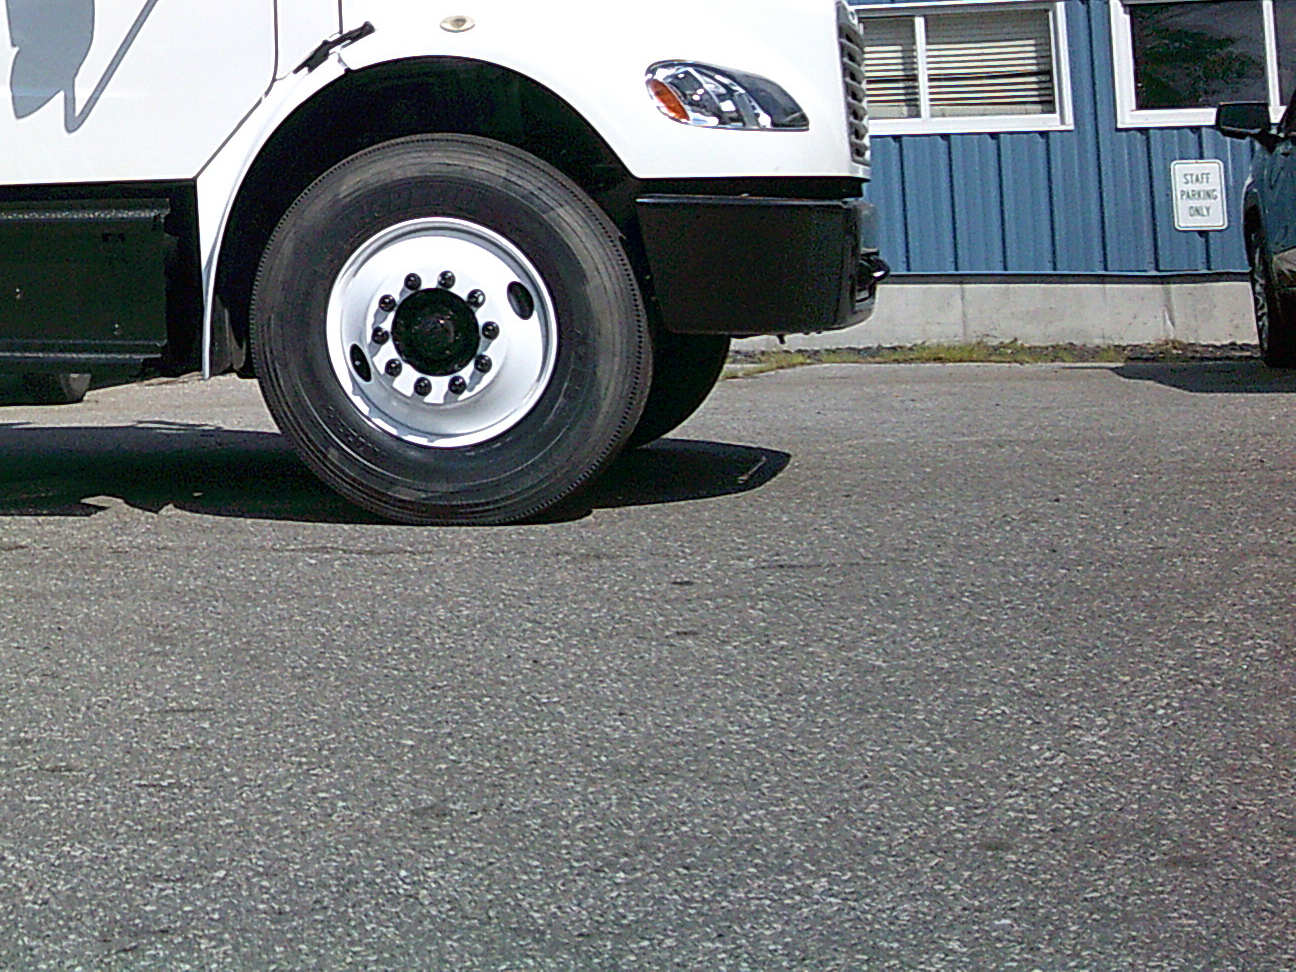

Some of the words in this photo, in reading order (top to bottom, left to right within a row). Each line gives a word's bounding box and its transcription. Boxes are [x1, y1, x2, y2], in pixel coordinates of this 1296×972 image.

[1183, 172, 1211, 185] STAFF
[1180, 188, 1218, 201] PARKING
[1188, 205, 1211, 217] ONLY
